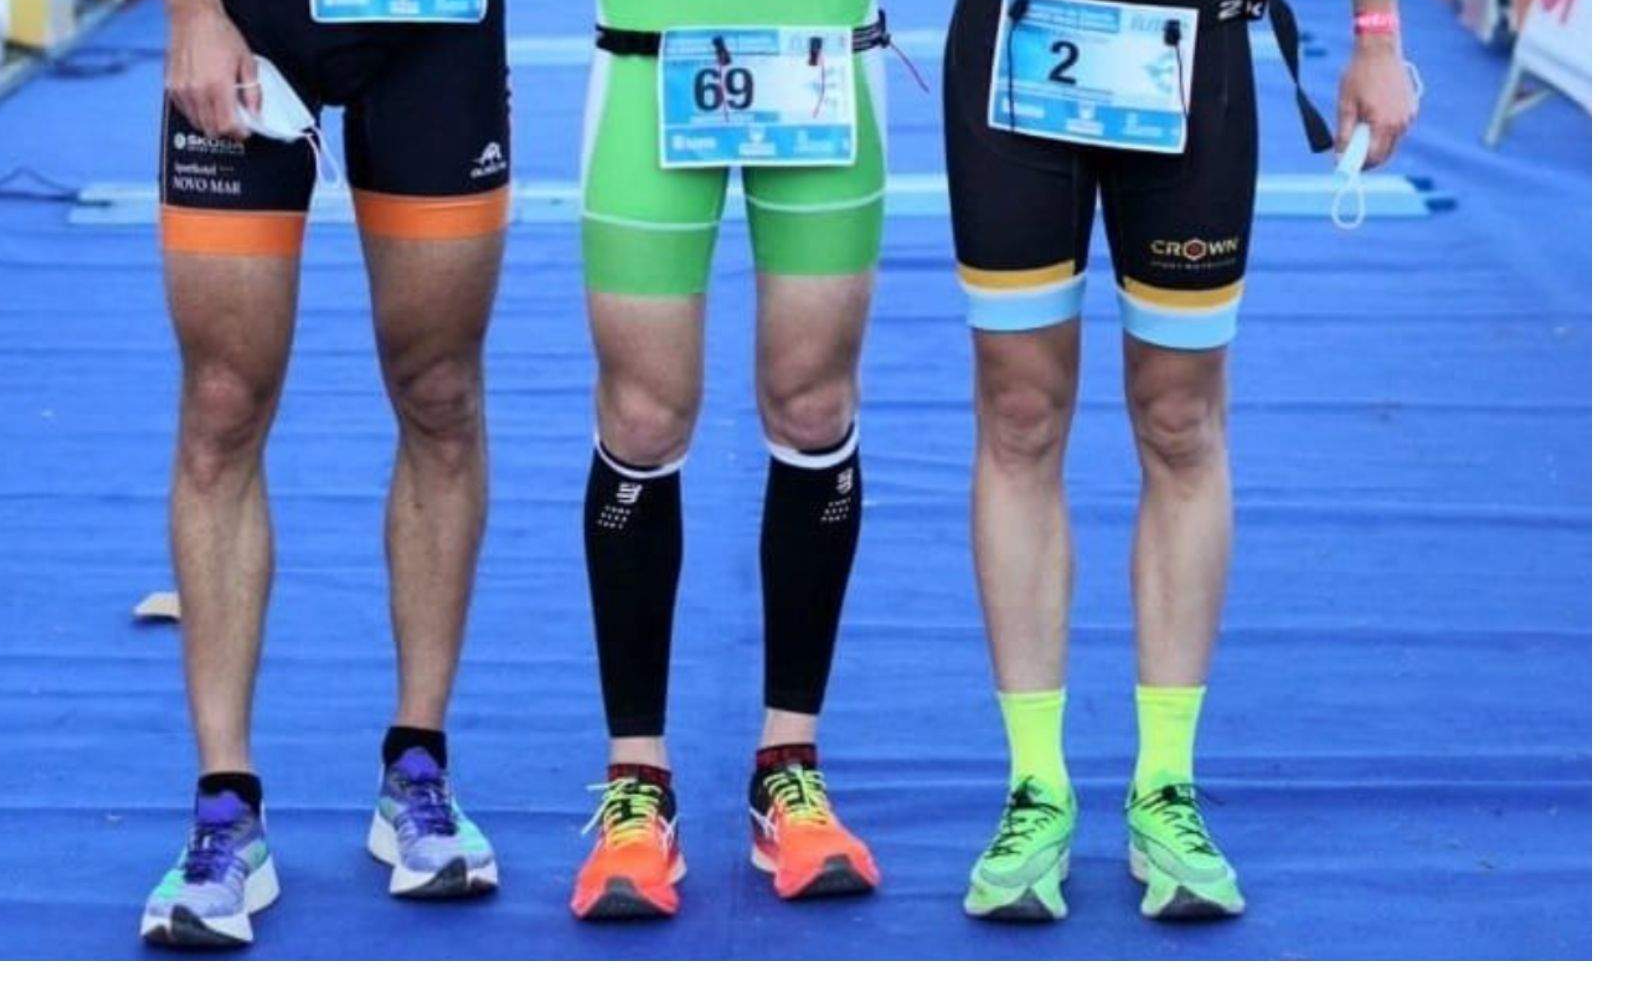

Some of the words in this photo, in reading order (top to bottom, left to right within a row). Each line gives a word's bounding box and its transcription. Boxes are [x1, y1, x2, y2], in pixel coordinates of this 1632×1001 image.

[1048, 40, 1081, 86] 2
[692, 67, 755, 113] 69
[1150, 237, 1239, 262] CROWN
